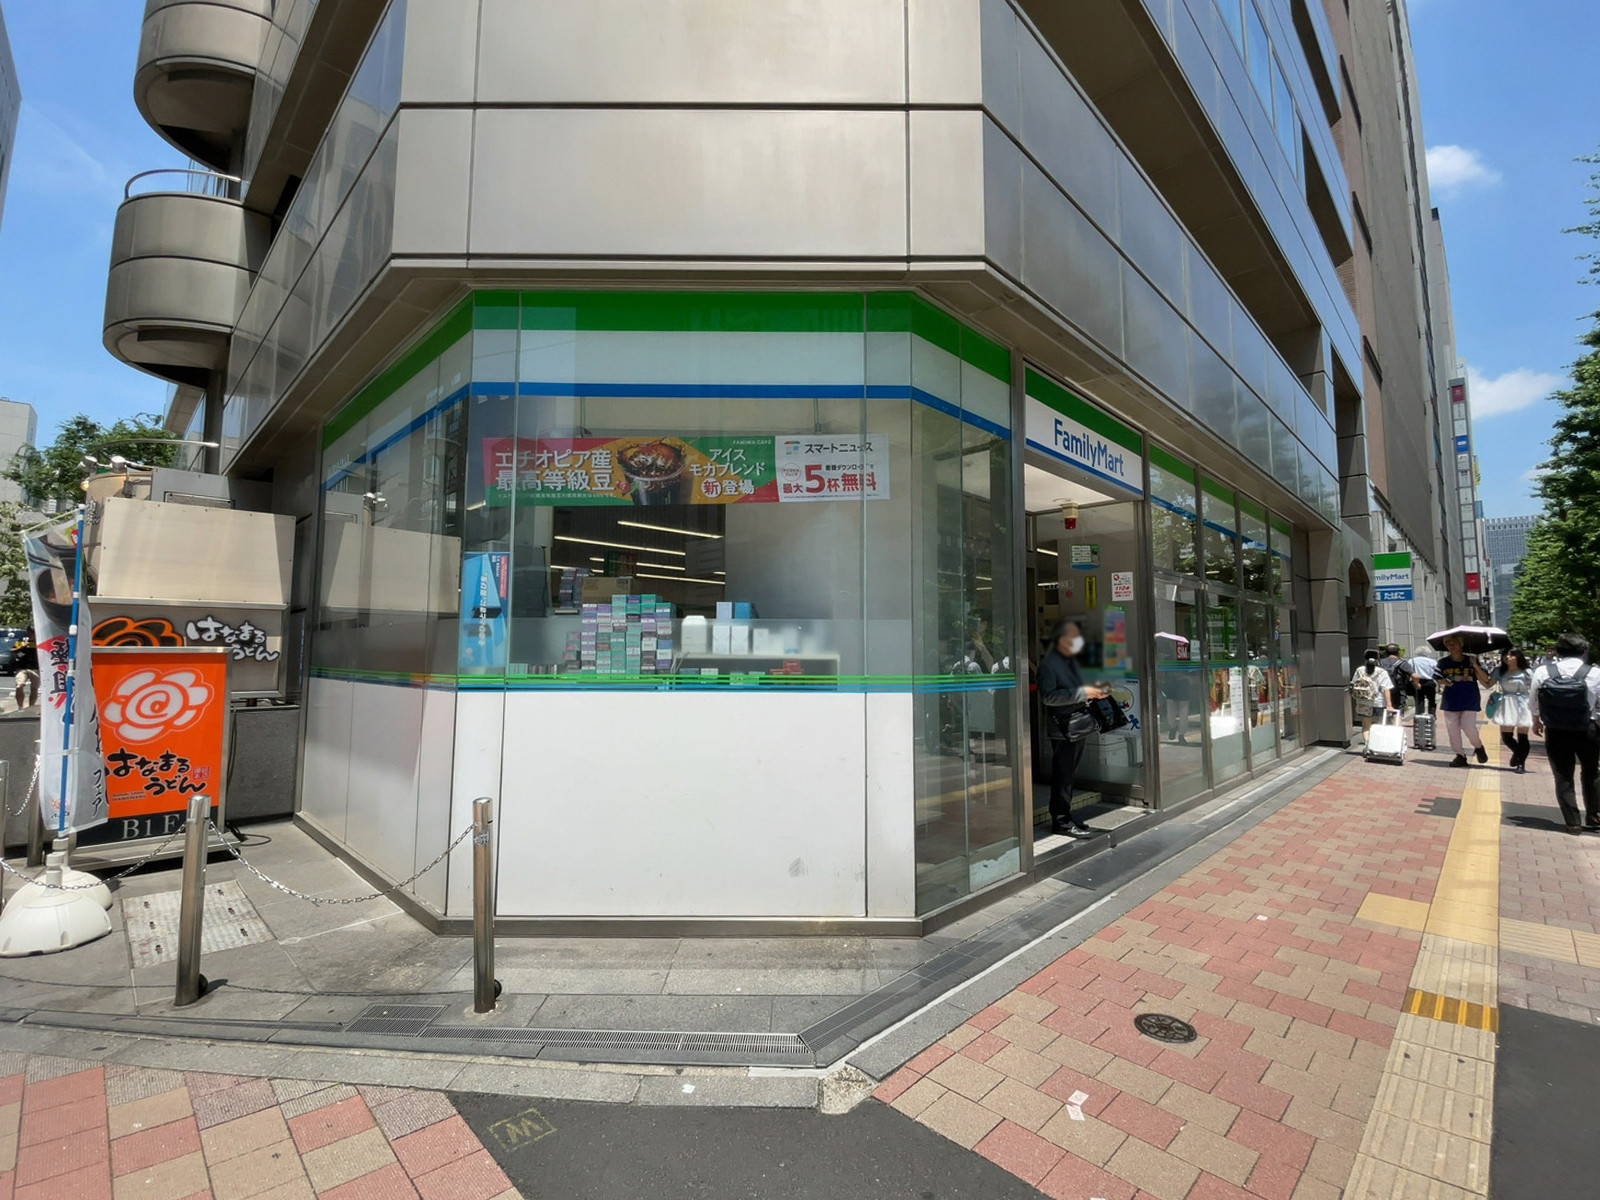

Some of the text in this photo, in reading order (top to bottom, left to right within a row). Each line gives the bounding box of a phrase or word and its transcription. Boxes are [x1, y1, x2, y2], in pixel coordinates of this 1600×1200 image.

[709, 448, 746, 461] アイス
[1054, 418, 1124, 477] FamilyMart
[495, 449, 612, 469] エチオピア産
[689, 461, 765, 477] モカブレンド
[495, 469, 615, 491] 最高等級豆
[702, 479, 755, 496] 新登場
[1383, 591, 1406, 600] たばこ
[186, 616, 265, 644] はなまる
[231, 643, 279, 661] うどん
[104, 747, 190, 777] はなまる
[144, 775, 207, 796] うどん
